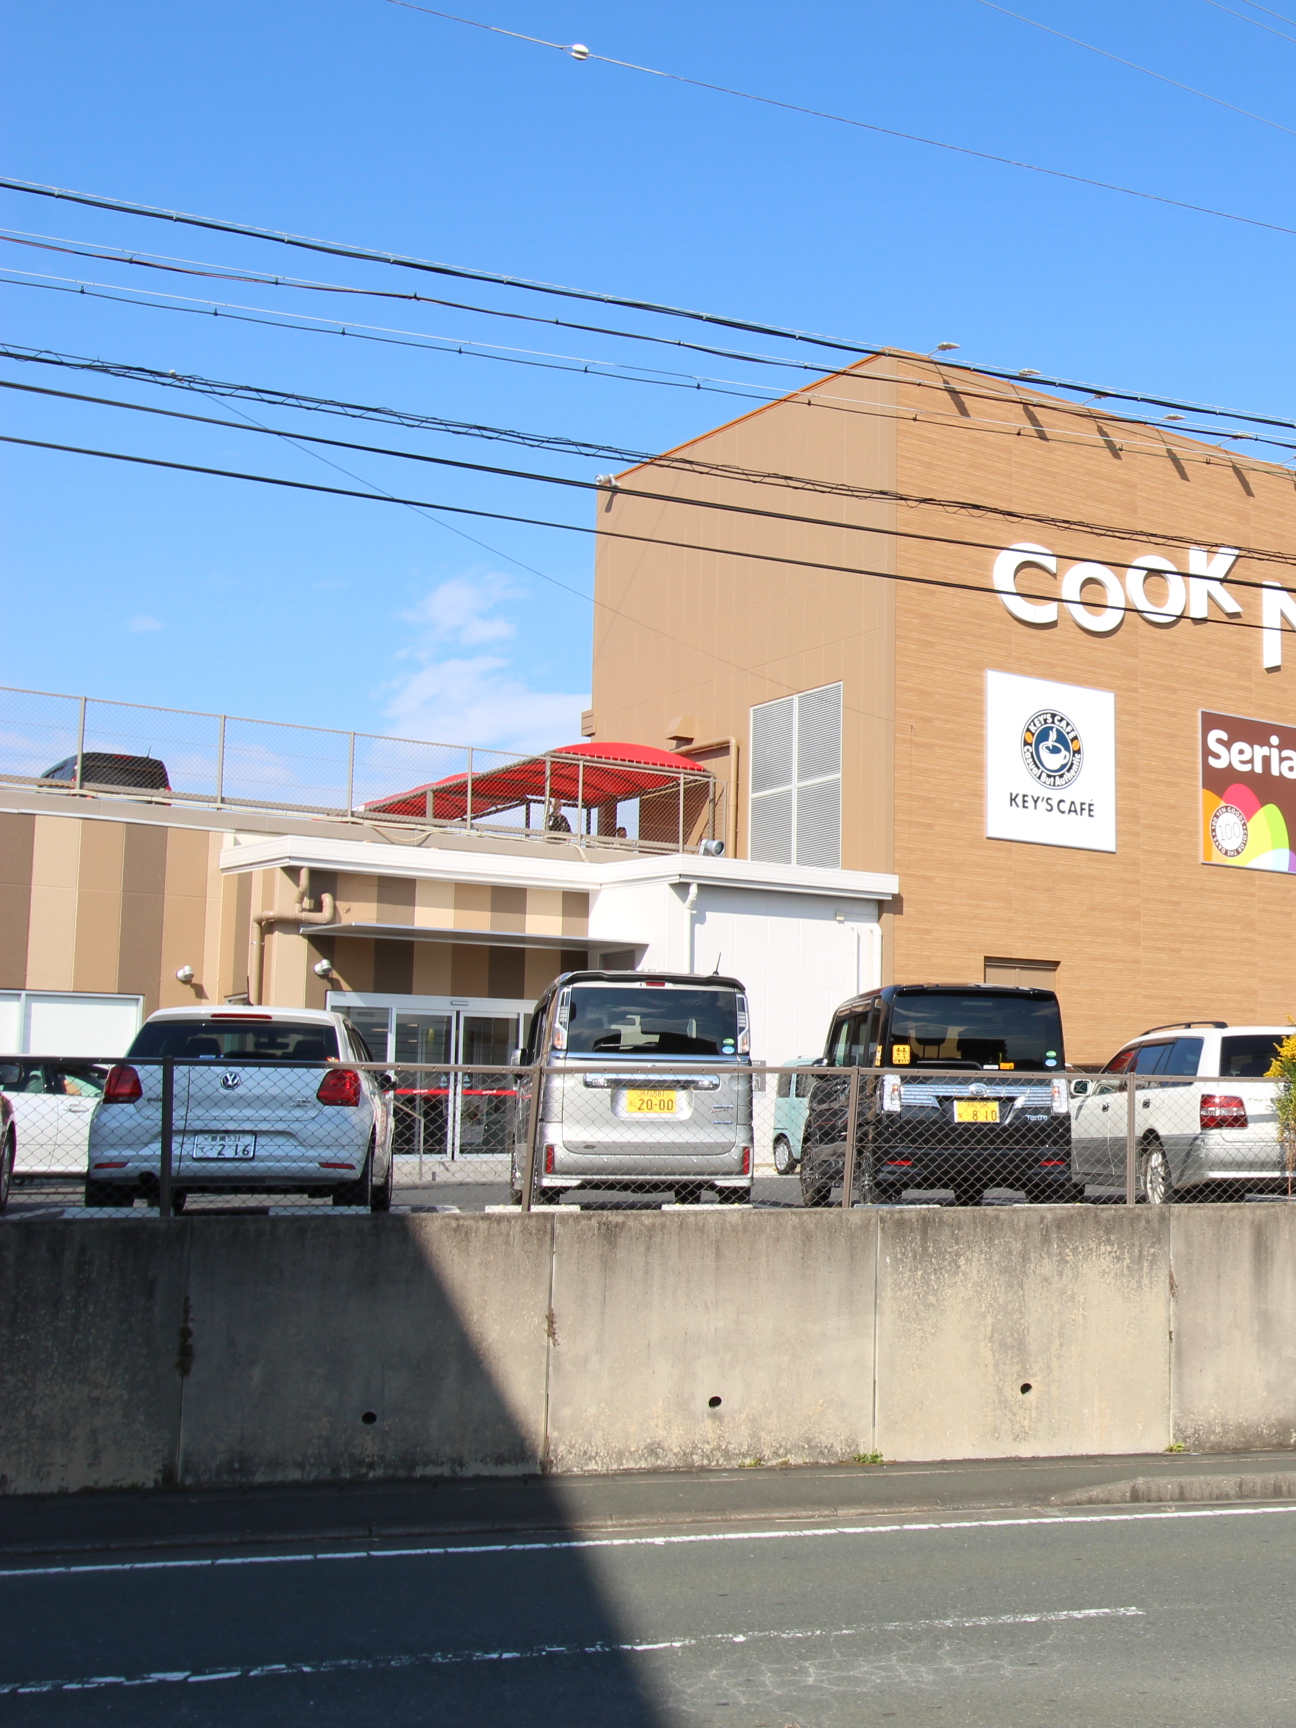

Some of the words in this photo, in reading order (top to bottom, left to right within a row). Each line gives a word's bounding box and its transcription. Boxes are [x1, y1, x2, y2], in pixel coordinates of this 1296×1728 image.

[992, 542, 1243, 633] COOK
[1028, 713, 1052, 733] KEY'S
[1024, 745, 1042, 777] Casual
[1040, 772, 1055, 786] But
[1055, 753, 1081, 786] Authentic
[1009, 792, 1054, 812] KEY'S
[1056, 798, 1094, 818] CAFÉ
[1218, 822, 1241, 841] 100
[637, 1098, 674, 1111] 20-00
